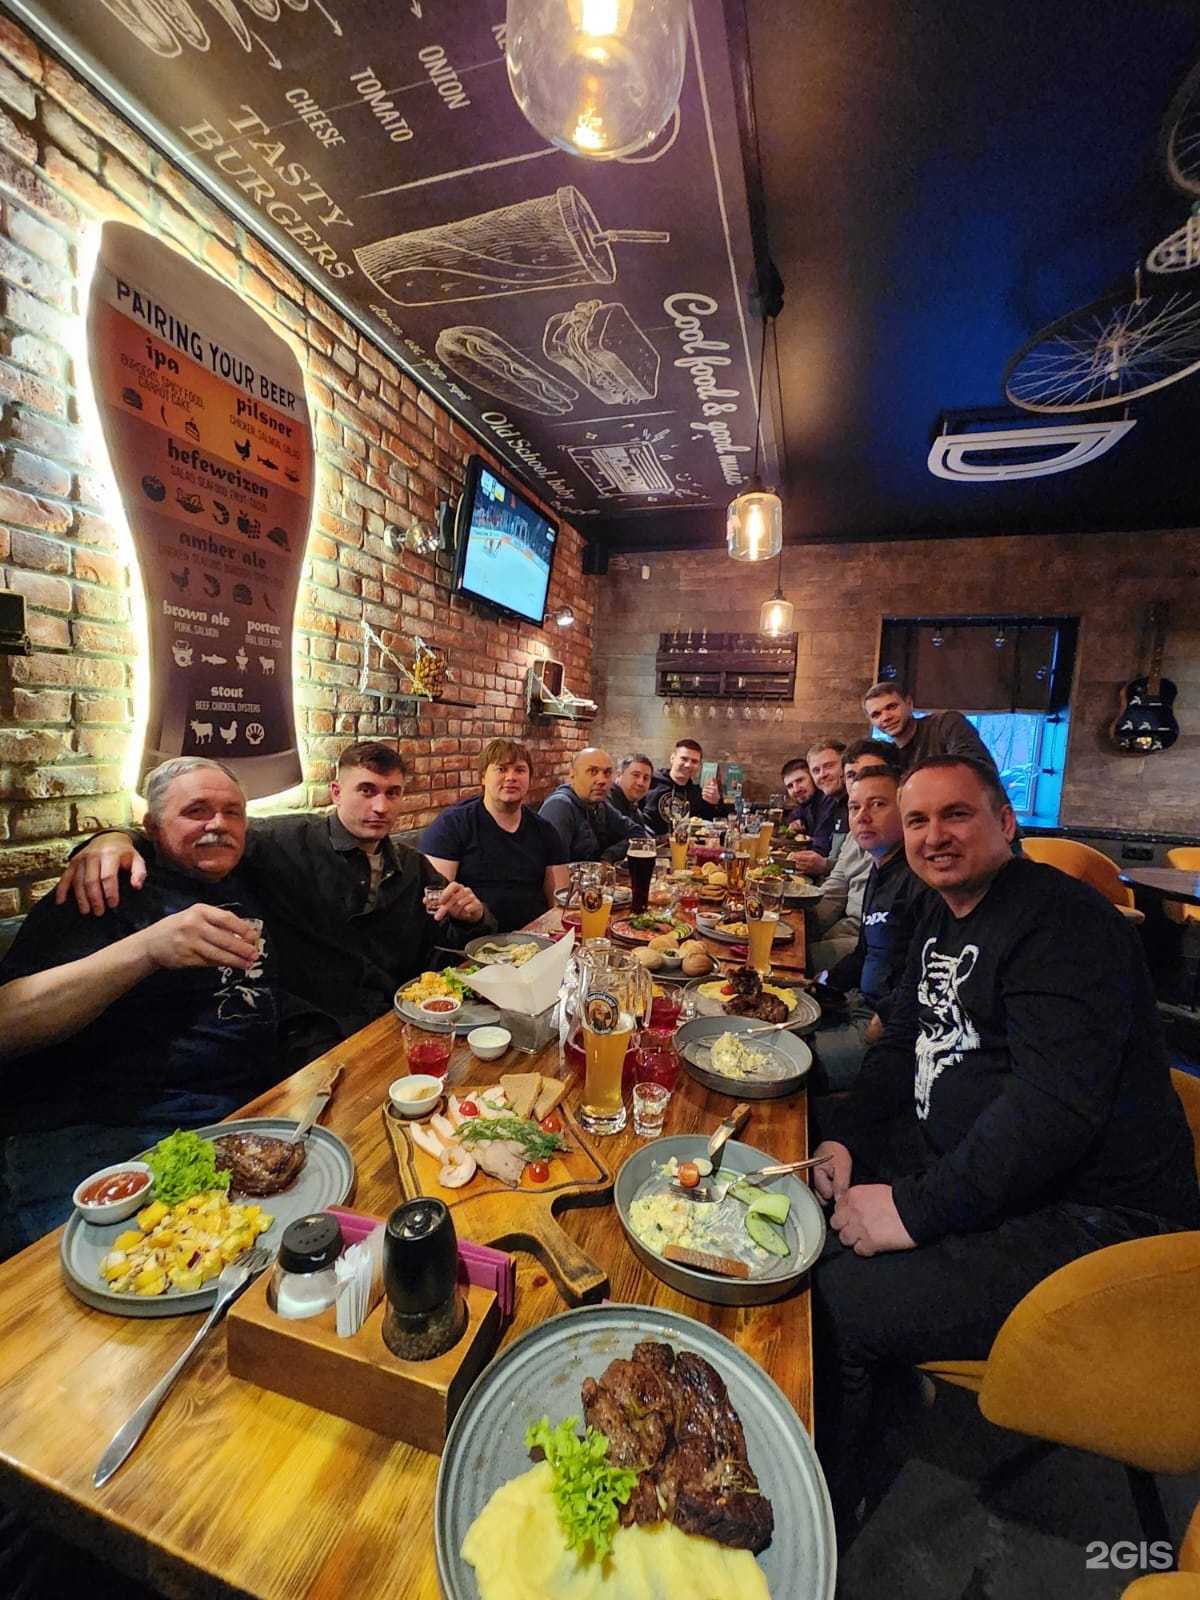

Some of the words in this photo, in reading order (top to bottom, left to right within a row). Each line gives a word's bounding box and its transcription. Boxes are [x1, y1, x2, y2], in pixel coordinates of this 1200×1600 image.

[418, 45, 471, 109] ONION
[285, 88, 346, 149] CHEESE
[350, 66, 414, 143] TOMATO
[229, 104, 354, 228] TASTY
[181, 118, 354, 279] BURGERS
[663, 292, 730, 354] Cool
[116, 279, 203, 362] PAIRING
[209, 342, 254, 394] YOUR
[259, 375, 296, 411] BEER
[144, 337, 180, 375] ipa
[674, 356, 740, 401] food
[237, 398, 292, 438] pilsner
[480, 410, 519, 439] Old
[702, 402, 738, 416] &
[690, 421, 751, 454] good
[168, 438, 268, 499] hefeweizen
[179, 532, 235, 560] amber
[242, 551, 266, 569] ale
[163, 600, 207, 622] brown
[211, 612, 231, 627] ale
[247, 620, 281, 635] porter
[211, 685, 244, 698] stout
